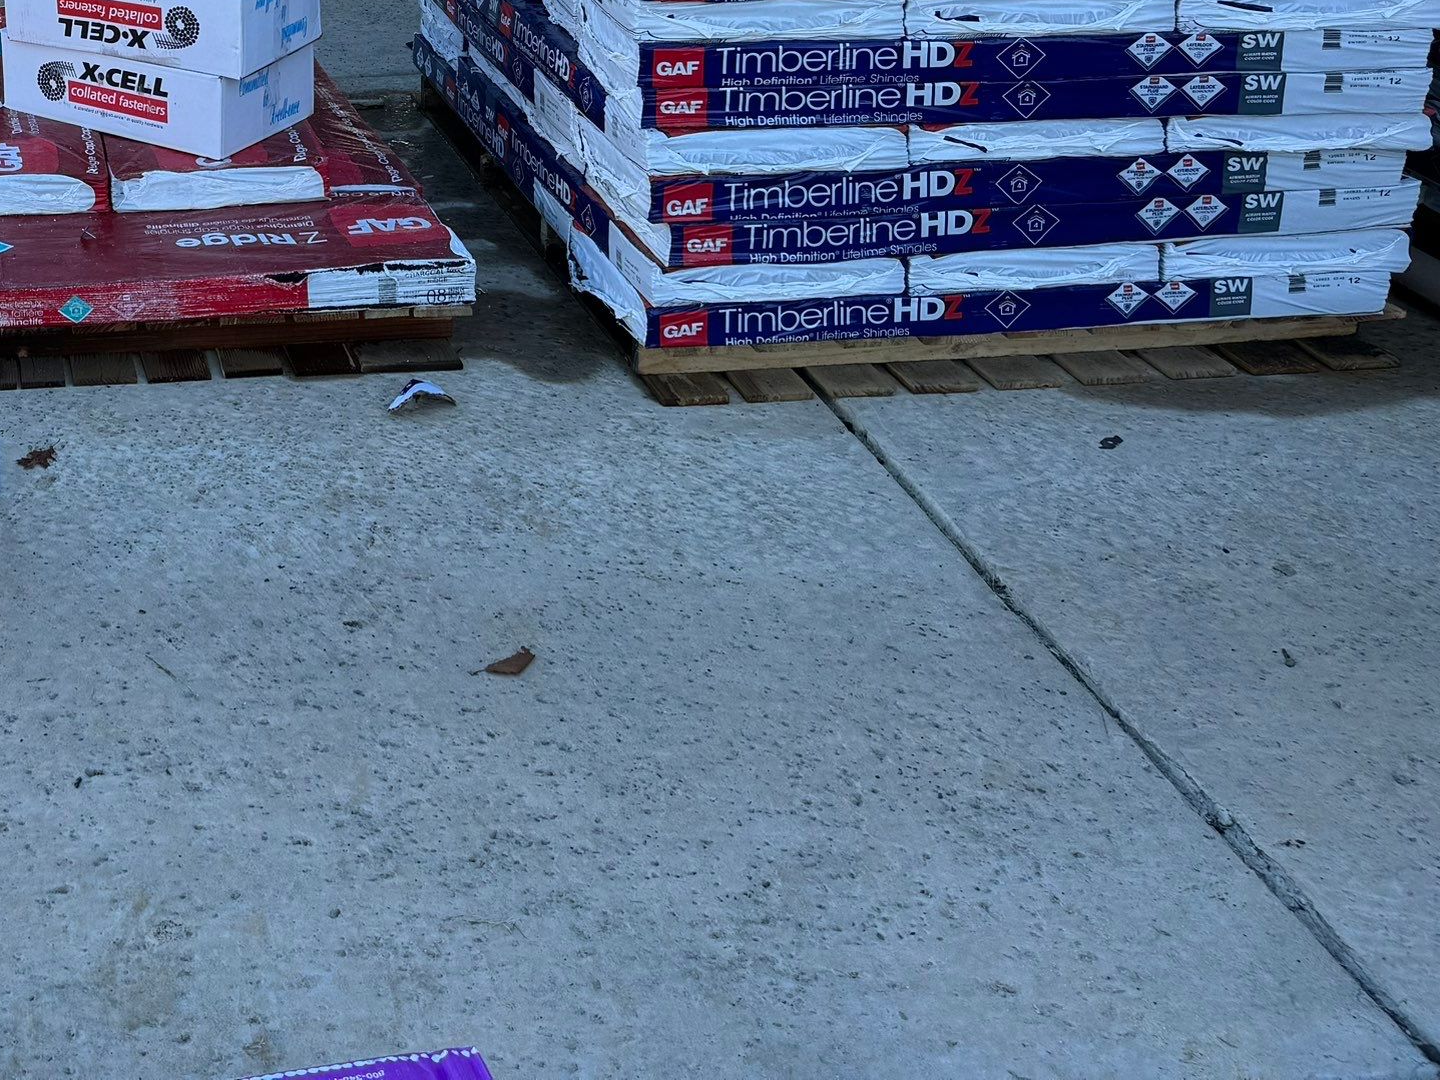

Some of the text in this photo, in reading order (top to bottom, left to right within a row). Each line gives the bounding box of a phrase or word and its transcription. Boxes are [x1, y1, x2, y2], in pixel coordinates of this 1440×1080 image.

[59, 0, 159, 25] collated fasteners
[513, 10, 556, 68] Timberline
[1241, 34, 1279, 49] SW
[656, 61, 700, 76] GAF
[716, 44, 898, 75] Timberline
[754, 74, 813, 85] Definition
[869, 72, 919, 84] Shingles
[1244, 75, 1283, 90] SW
[1388, 77, 1402, 85] 12
[71, 85, 166, 116] collated fasteners
[660, 100, 703, 115] GAF
[719, 84, 901, 112] Timberline
[725, 110, 923, 127] High Definition Lifetime Shingles
[510, 127, 555, 190] Timberline
[1227, 156, 1265, 171] SW
[1363, 153, 1376, 161] 12
[666, 199, 708, 216] GAF
[724, 178, 898, 211] Timberline
[1245, 193, 1281, 209] SW
[348, 217, 432, 236] GAF
[686, 237, 727, 253] GAF
[744, 218, 916, 248] Timberline
[175, 231, 298, 249] Ridge
[749, 242, 937, 265] High Definition Lifetime Shingles
[1213, 279, 1249, 294] SW
[663, 322, 704, 338] GAF
[718, 303, 888, 334] Timberline
[755, 326, 910, 344] Definition Lifetime Shingles
